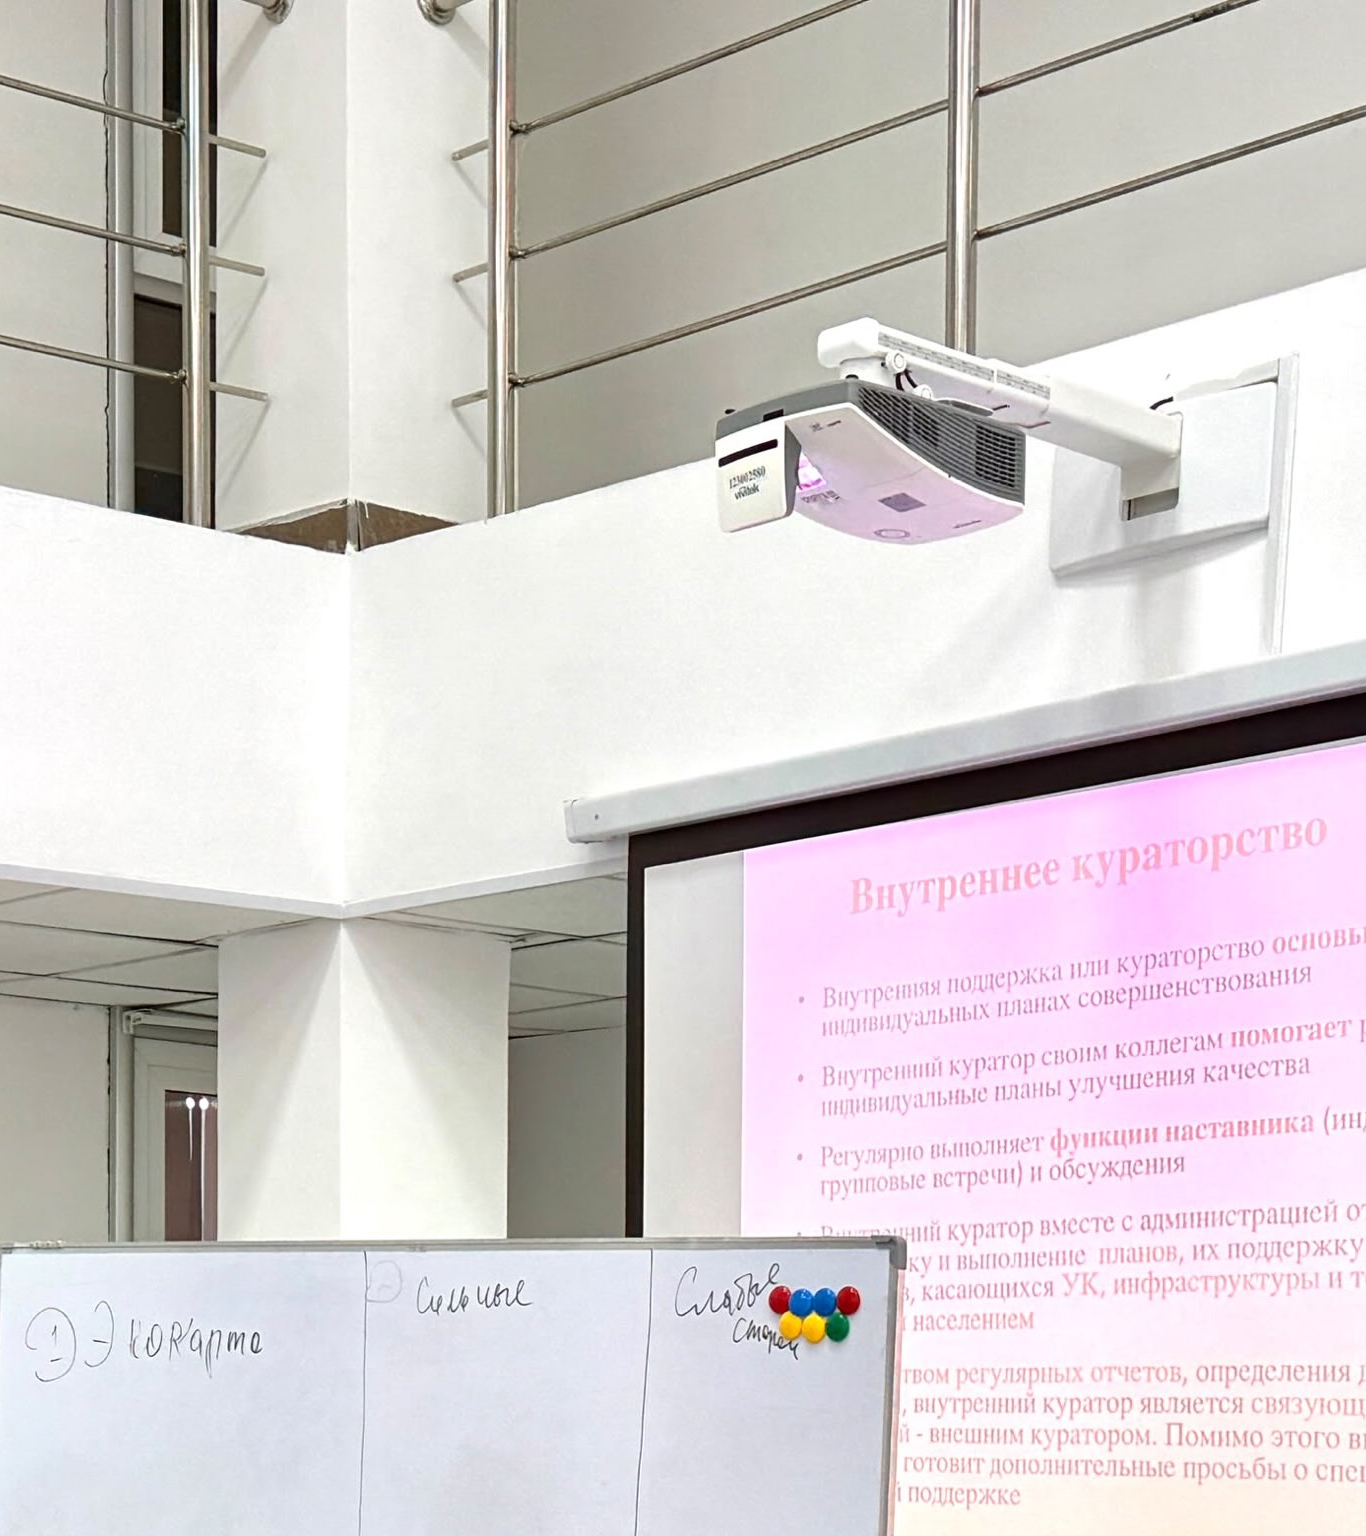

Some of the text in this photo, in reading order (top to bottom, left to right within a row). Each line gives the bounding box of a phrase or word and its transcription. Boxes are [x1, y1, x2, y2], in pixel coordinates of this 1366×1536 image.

[850, 817, 1328, 918] Внутреннее кураторство
[823, 976, 941, 1011] Внутренняя
[947, 963, 1062, 995] поддержка
[1070, 958, 1109, 979] или
[1116, 938, 1265, 979] кураторство
[822, 966, 1312, 1038] индивидуальных планах совершенствования
[822, 1056, 943, 1091] Внутренний
[949, 1052, 1035, 1079] куратор
[1041, 1045, 1107, 1066] своим
[1115, 1029, 1223, 1065] коллегам
[1230, 1017, 1352, 1050] помогает
[821, 1056, 1310, 1118] индивидуальные планы улучшения качества
[820, 1140, 924, 1172] Регулярно
[930, 1132, 1044, 1161] выполняет
[1050, 1123, 1159, 1158] функции
[1165, 1113, 1314, 1144] наставника
[820, 1153, 1185, 1201] групповые встречи) и обсуждения
[948, 1221, 1034, 1249] куратор
[1040, 1213, 1115, 1238] вместе
[1122, 1214, 1133, 1232] с
[1140, 1199, 1338, 1234] администрацией
[939, 1253, 950, 1271] и
[957, 1248, 1086, 1274] выполнение
[1099, 1244, 1184, 1265] планов,
[1192, 1242, 1220, 1263] их
[1227, 1237, 1364, 1264] поддержку
[922, 1280, 1054, 1304] касающихся
[1060, 1272, 1105, 1299] УК,
[1114, 1269, 1320, 1300] инфраструктуры
[1329, 1270, 1342, 1290] и
[913, 1311, 1034, 1334] населением
[956, 1365, 1084, 1391] регулярных
[1091, 1364, 1188, 1387] отчетов,
[1195, 1364, 1351, 1389] определения
[913, 1391, 1036, 1420] внутренний
[1043, 1394, 1134, 1421] куратор
[1140, 1395, 1244, 1415] является
[930, 1426, 1024, 1445] внешним
[1031, 1425, 1157, 1451] куратором.
[1166, 1423, 1263, 1449] Помимо
[1271, 1429, 1340, 1451] этого
[904, 1456, 985, 1474] готовит
[989, 1456, 1176, 1479] дополнительные
[1184, 1457, 1287, 1486] просьбы
[1294, 1461, 1308, 1481] о
[908, 1484, 1021, 1510] поддержке
